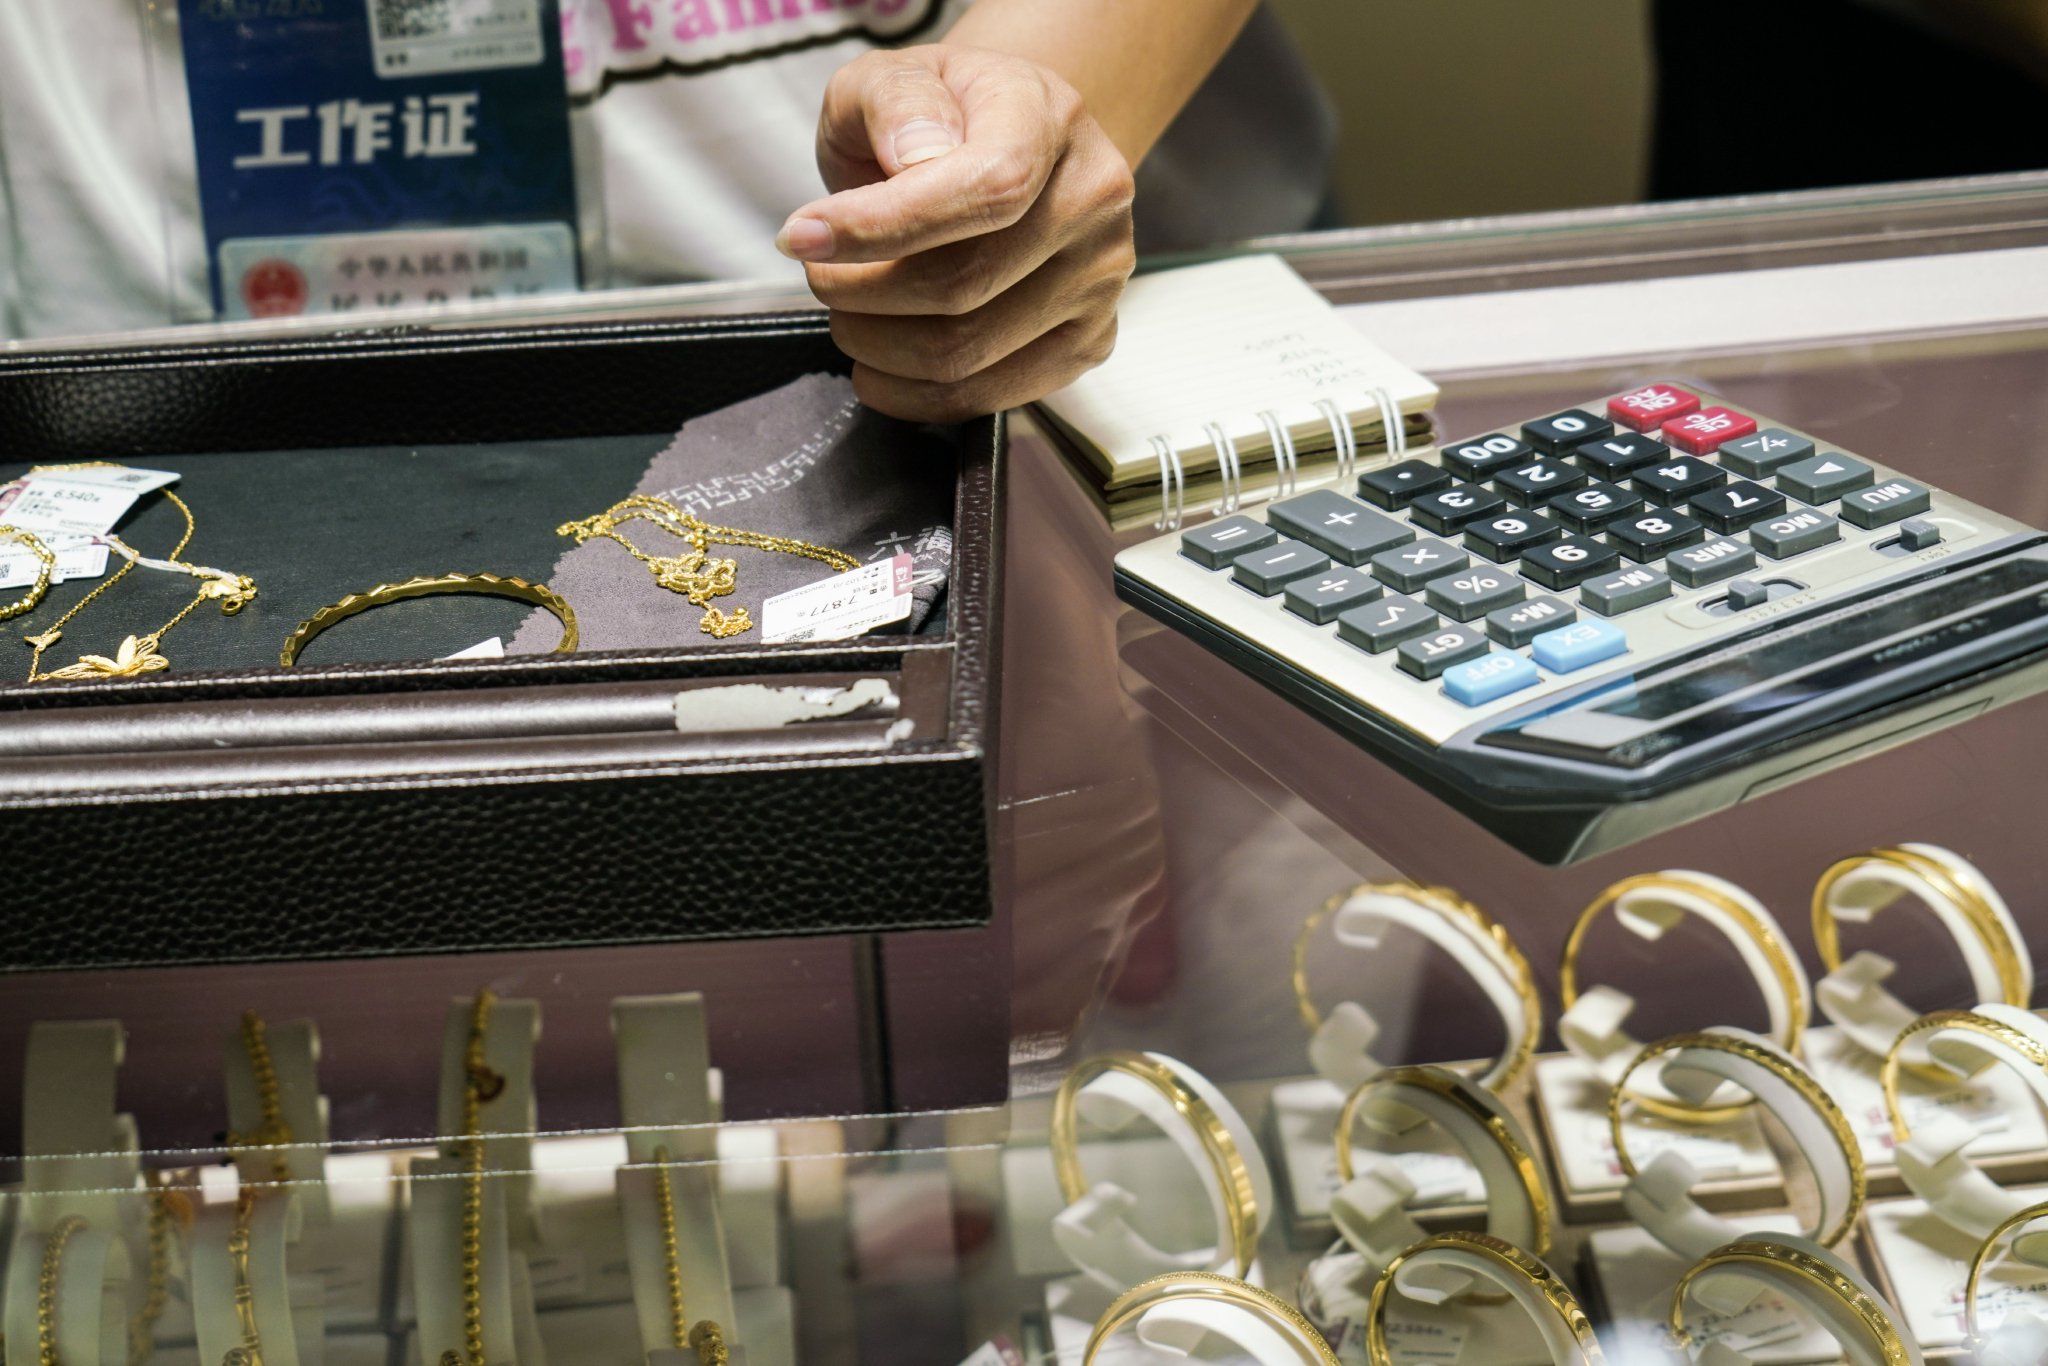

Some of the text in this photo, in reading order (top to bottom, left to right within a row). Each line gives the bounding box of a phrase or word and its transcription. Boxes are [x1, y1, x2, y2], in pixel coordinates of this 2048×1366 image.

[234, 92, 479, 169] 工作证
[1551, 416, 1588, 432] 0
[1458, 437, 1518, 460] 00
[1603, 441, 1635, 457] 1
[1517, 464, 1557, 482] 2
[1657, 465, 1689, 481] 4
[1438, 492, 1474, 508] 3
[1575, 490, 1612, 511] 5
[1725, 490, 1760, 508] 7
[1861, 482, 1913, 504] MU
[1635, 517, 1673, 535] 8
[1769, 512, 1822, 534] MC
[1682, 540, 1739, 563] MR
[1421, 632, 1466, 656] GT
[1558, 624, 1602, 647] EX
[1462, 656, 1517, 681] OFF
